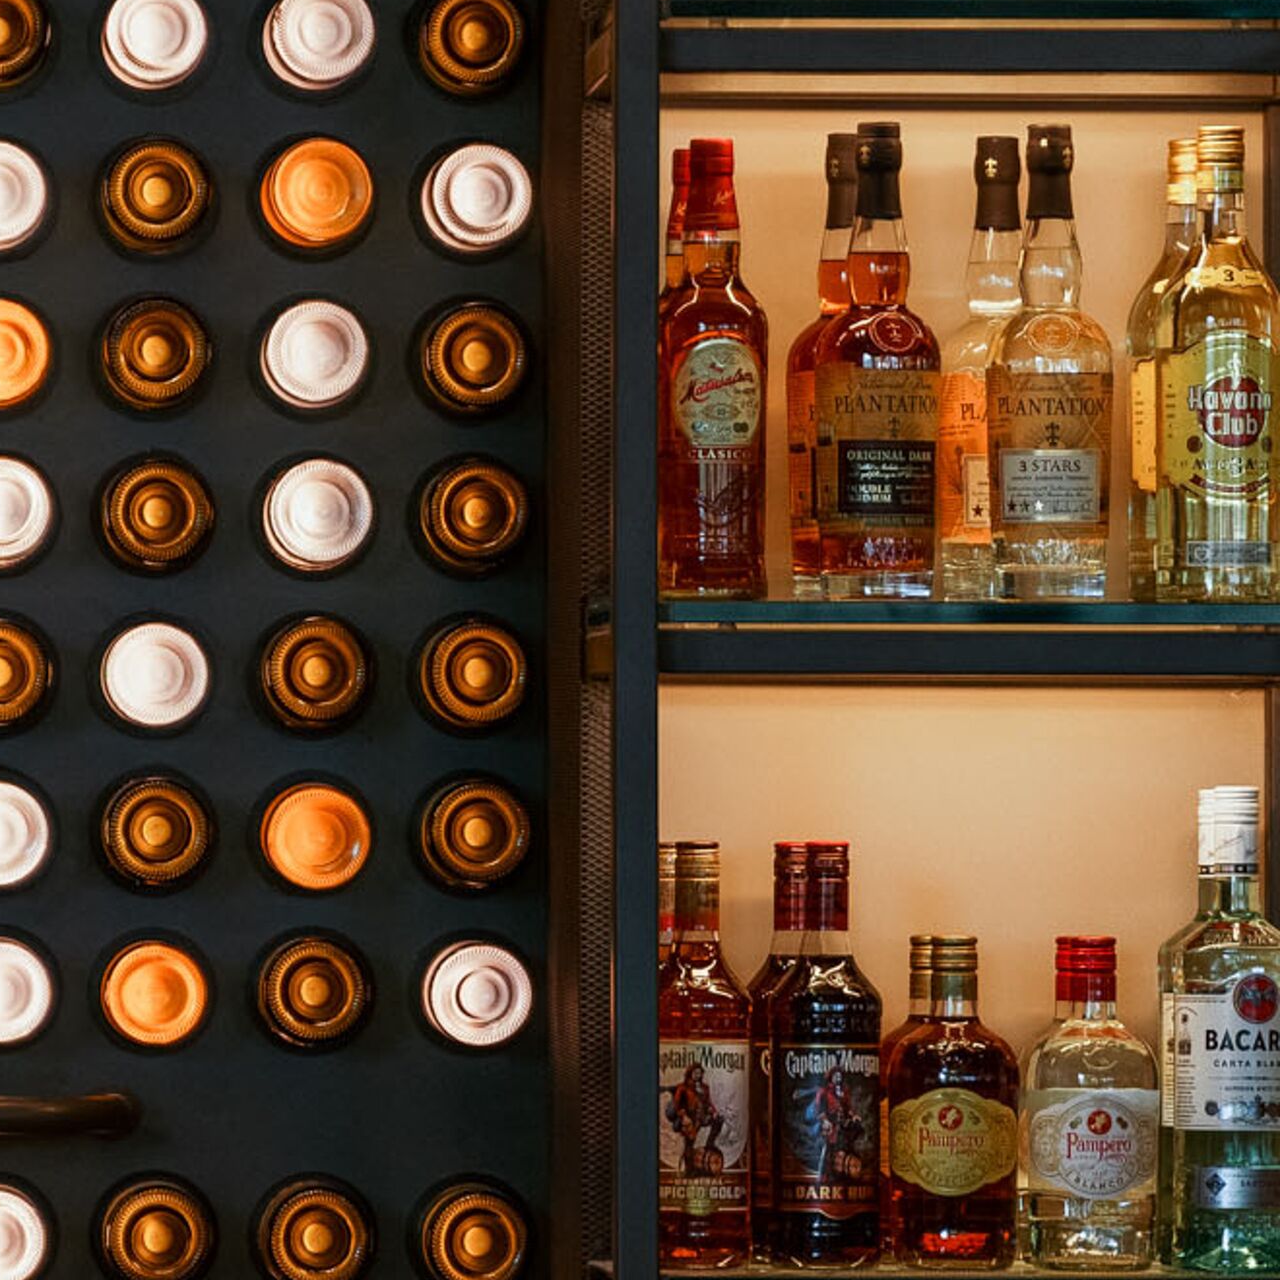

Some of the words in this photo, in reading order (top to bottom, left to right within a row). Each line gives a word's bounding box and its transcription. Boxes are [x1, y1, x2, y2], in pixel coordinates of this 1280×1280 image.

[1223, 269, 1234, 282] 3
[997, 397, 1106, 417] PLANTATION
[1188, 384, 1272, 411] Havana
[1205, 412, 1259, 436] Club
[846, 450, 905, 461] ORIGINAL
[1031, 459, 1081, 472] STARS
[659, 1046, 695, 1072] ptain
[785, 1050, 835, 1078] Captain
[1213, 1059, 1251, 1067] CARTA
[917, 1127, 984, 1155] Pampero
[1066, 1132, 1132, 1160] Pampero
[796, 1186, 842, 1200] DARK
[1073, 1176, 1125, 1190] BLANCO
